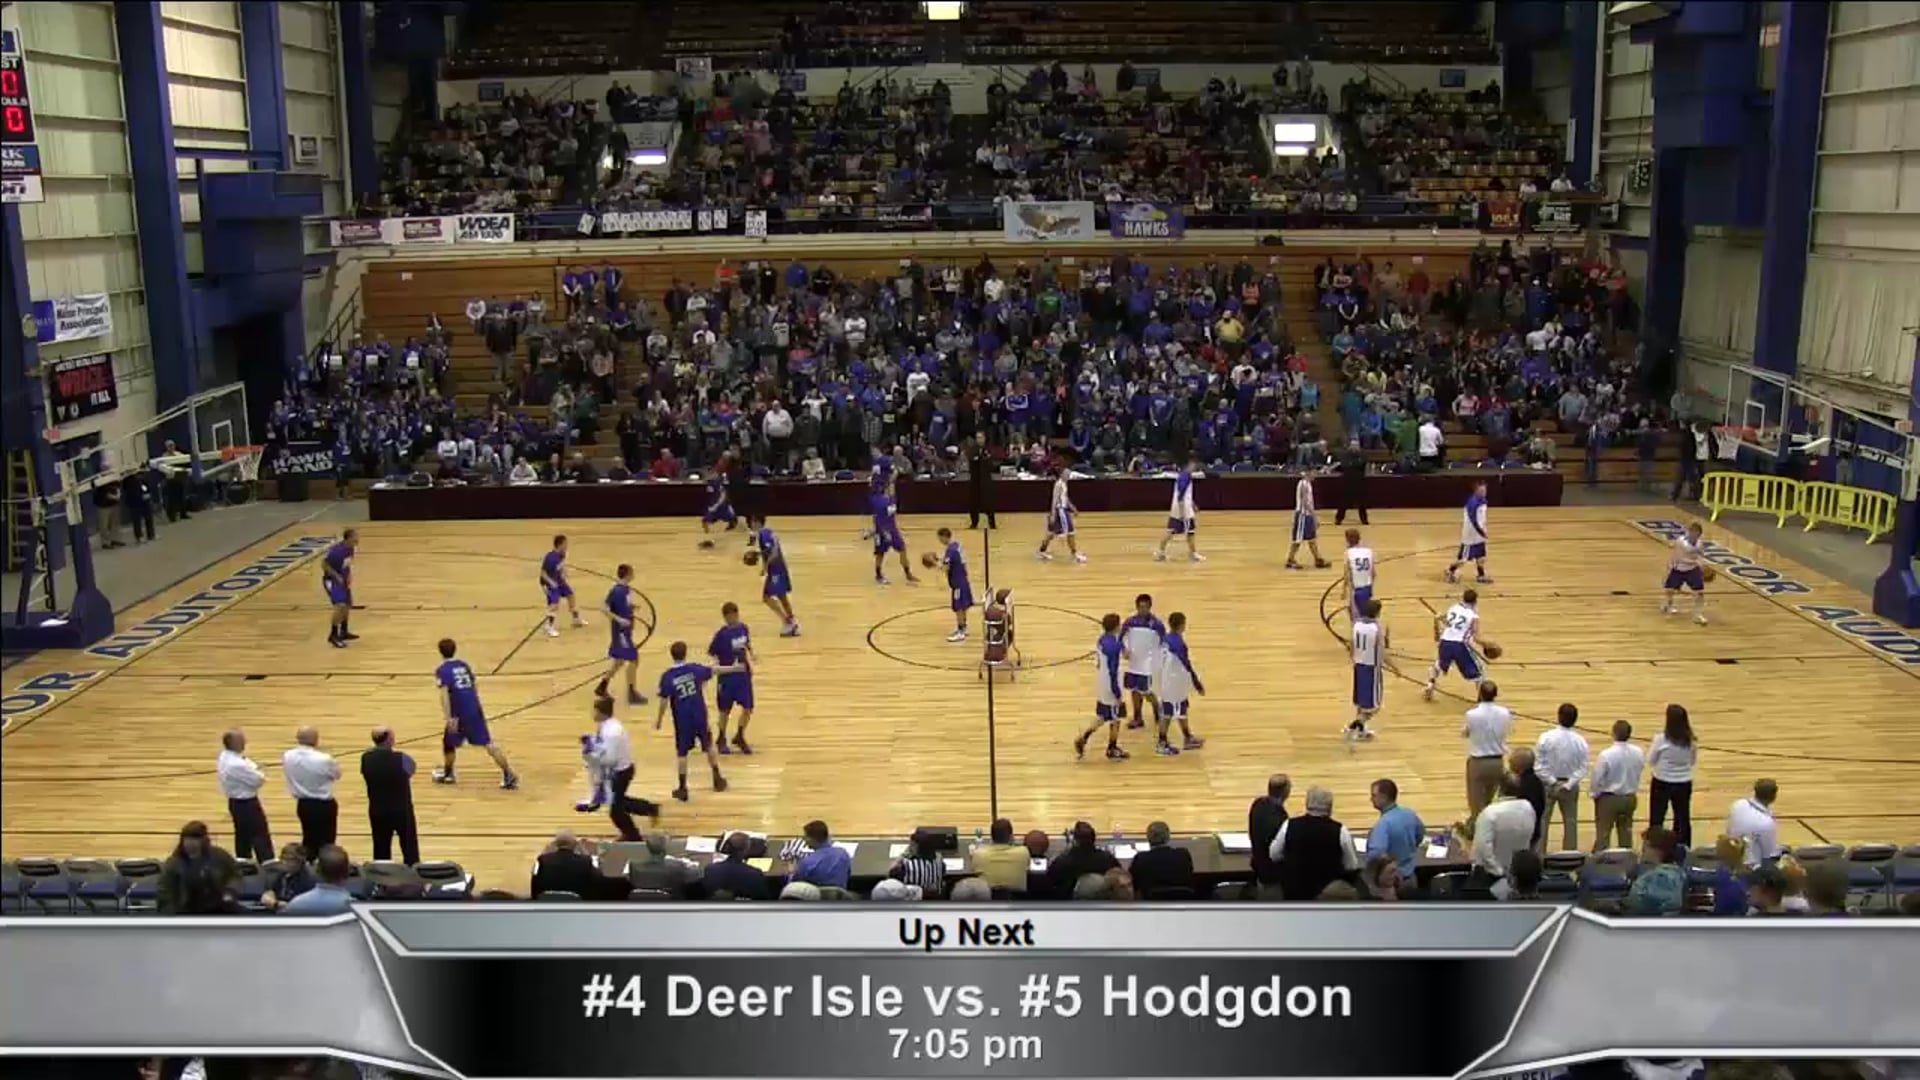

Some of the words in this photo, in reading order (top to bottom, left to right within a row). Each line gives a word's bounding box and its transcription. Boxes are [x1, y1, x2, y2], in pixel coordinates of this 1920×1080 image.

[6, 107, 25, 132] 0
[459, 216, 510, 230] WDEA
[1124, 221, 1169, 236] HAWKS
[60, 317, 104, 331] Association
[1355, 557, 1369, 572] 50
[84, 534, 337, 661] AUDITORIUM
[1447, 612, 1467, 631] 22
[1355, 629, 1368, 651] 11
[454, 674, 472, 689] 23
[675, 680, 697, 698] 32
